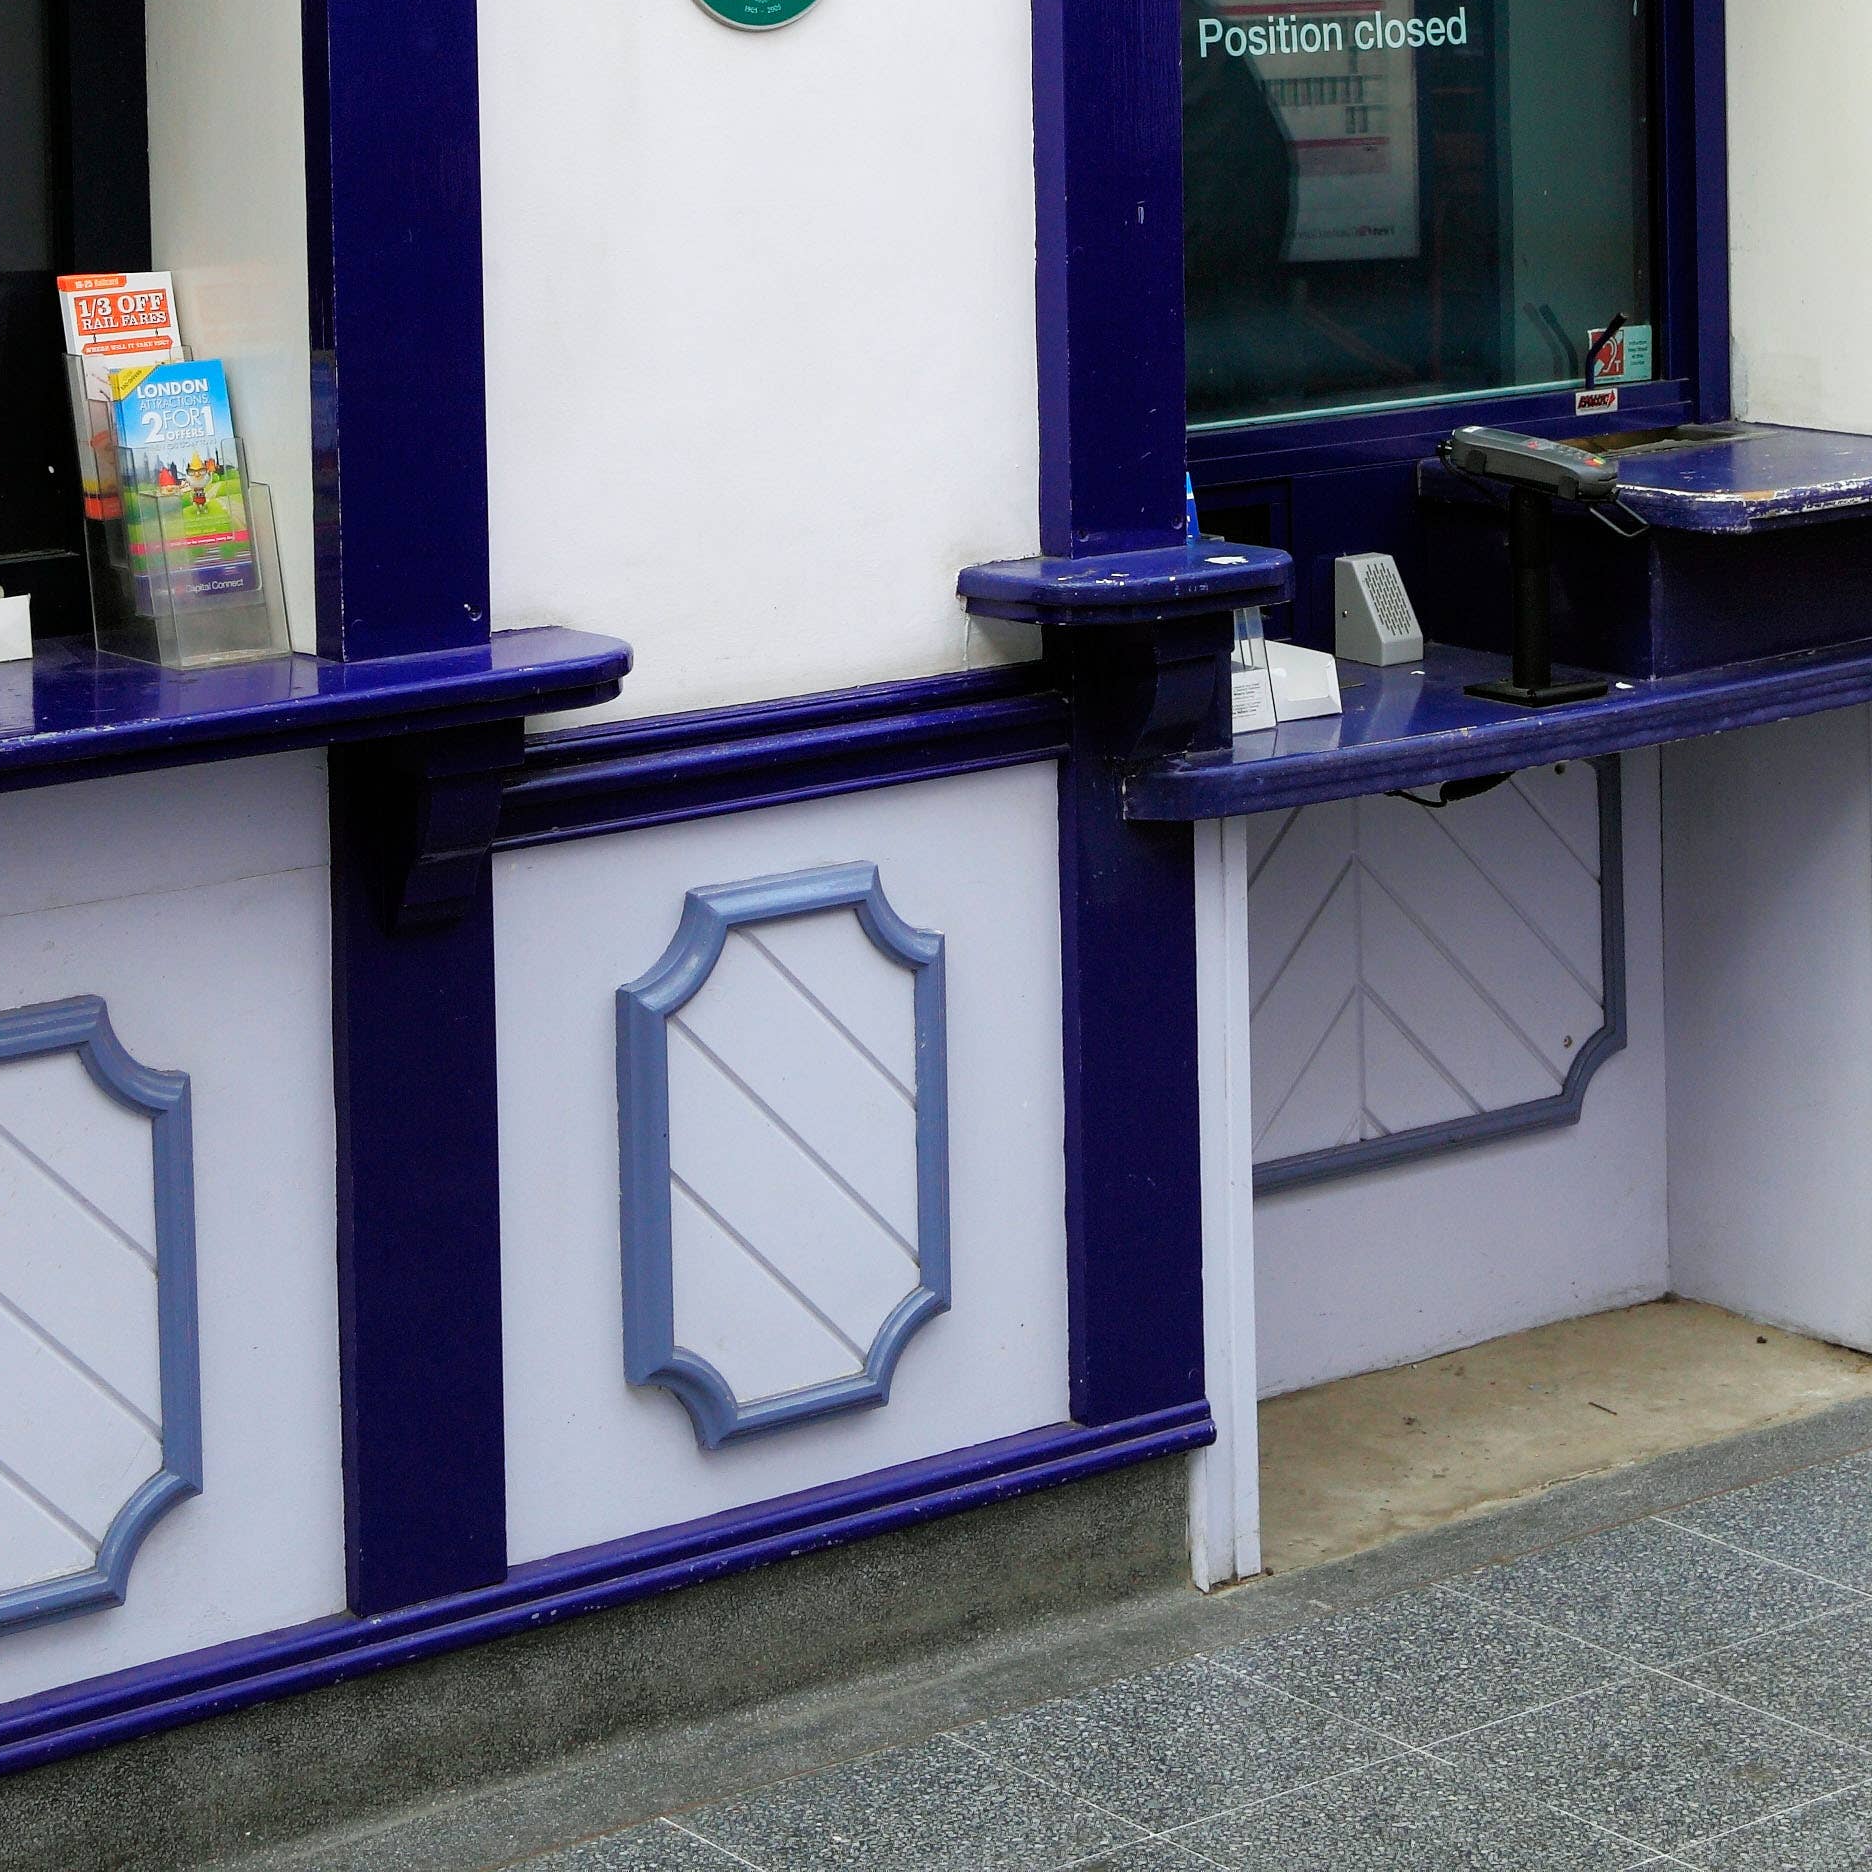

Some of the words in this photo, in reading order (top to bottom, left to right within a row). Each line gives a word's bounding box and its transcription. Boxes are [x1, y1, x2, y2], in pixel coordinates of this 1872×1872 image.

[1199, 14, 1343, 58] Position
[1354, 7, 1467, 48] closed
[79, 297, 112, 318] 1/3
[117, 293, 164, 314] OFF
[82, 317, 119, 331] RAIL
[122, 312, 167, 327] FARES
[137, 379, 209, 399] LONDON
[140, 394, 209, 411] ATTRACTIONS
[167, 429, 204, 441] OFFERS
